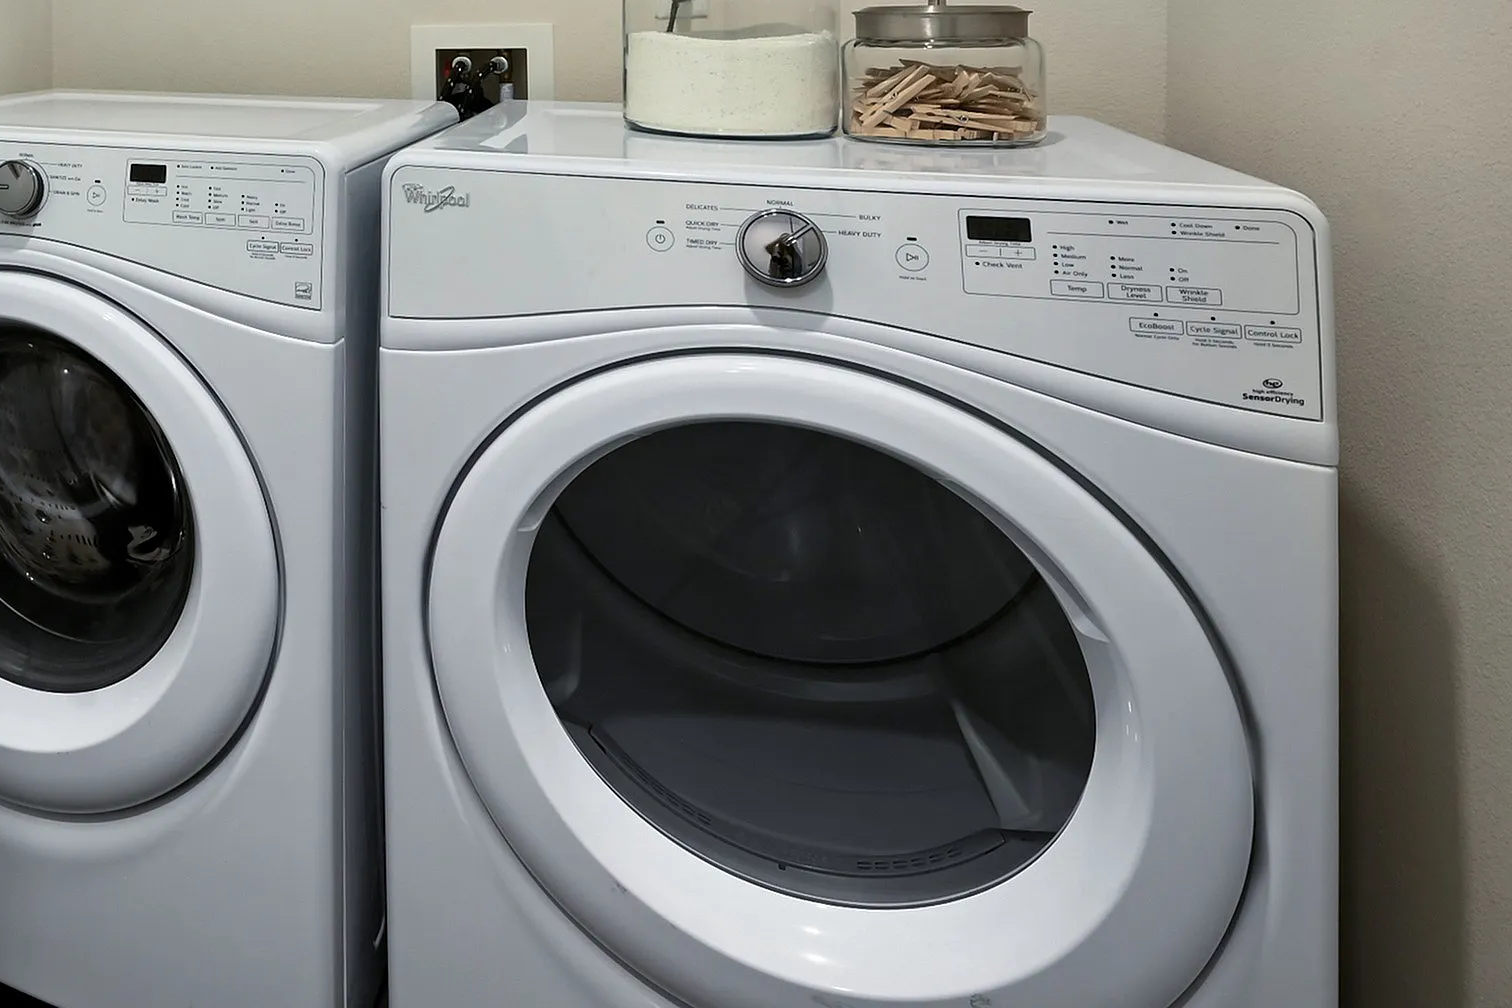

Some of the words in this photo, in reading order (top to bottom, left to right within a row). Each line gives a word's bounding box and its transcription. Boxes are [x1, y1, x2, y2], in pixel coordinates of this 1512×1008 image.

[402, 183, 470, 213] Whirlpool
[685, 203, 719, 211] DELICATES
[766, 199, 794, 207] NORMAL
[1073, 270, 1088, 278] Only
[1067, 284, 1088, 293] Temp
[1120, 285, 1151, 293] Dryness
[1179, 288, 1209, 296] Wrinkle
[1182, 295, 1207, 303] Shield
[1138, 322, 1175, 331] EcoBoost
[1189, 325, 1211, 334] Cycle
[1212, 326, 1239, 336] Signal
[1247, 328, 1278, 338] Control
[1280, 331, 1299, 340] Lock
[1242, 392, 1305, 406] SensorDrying
